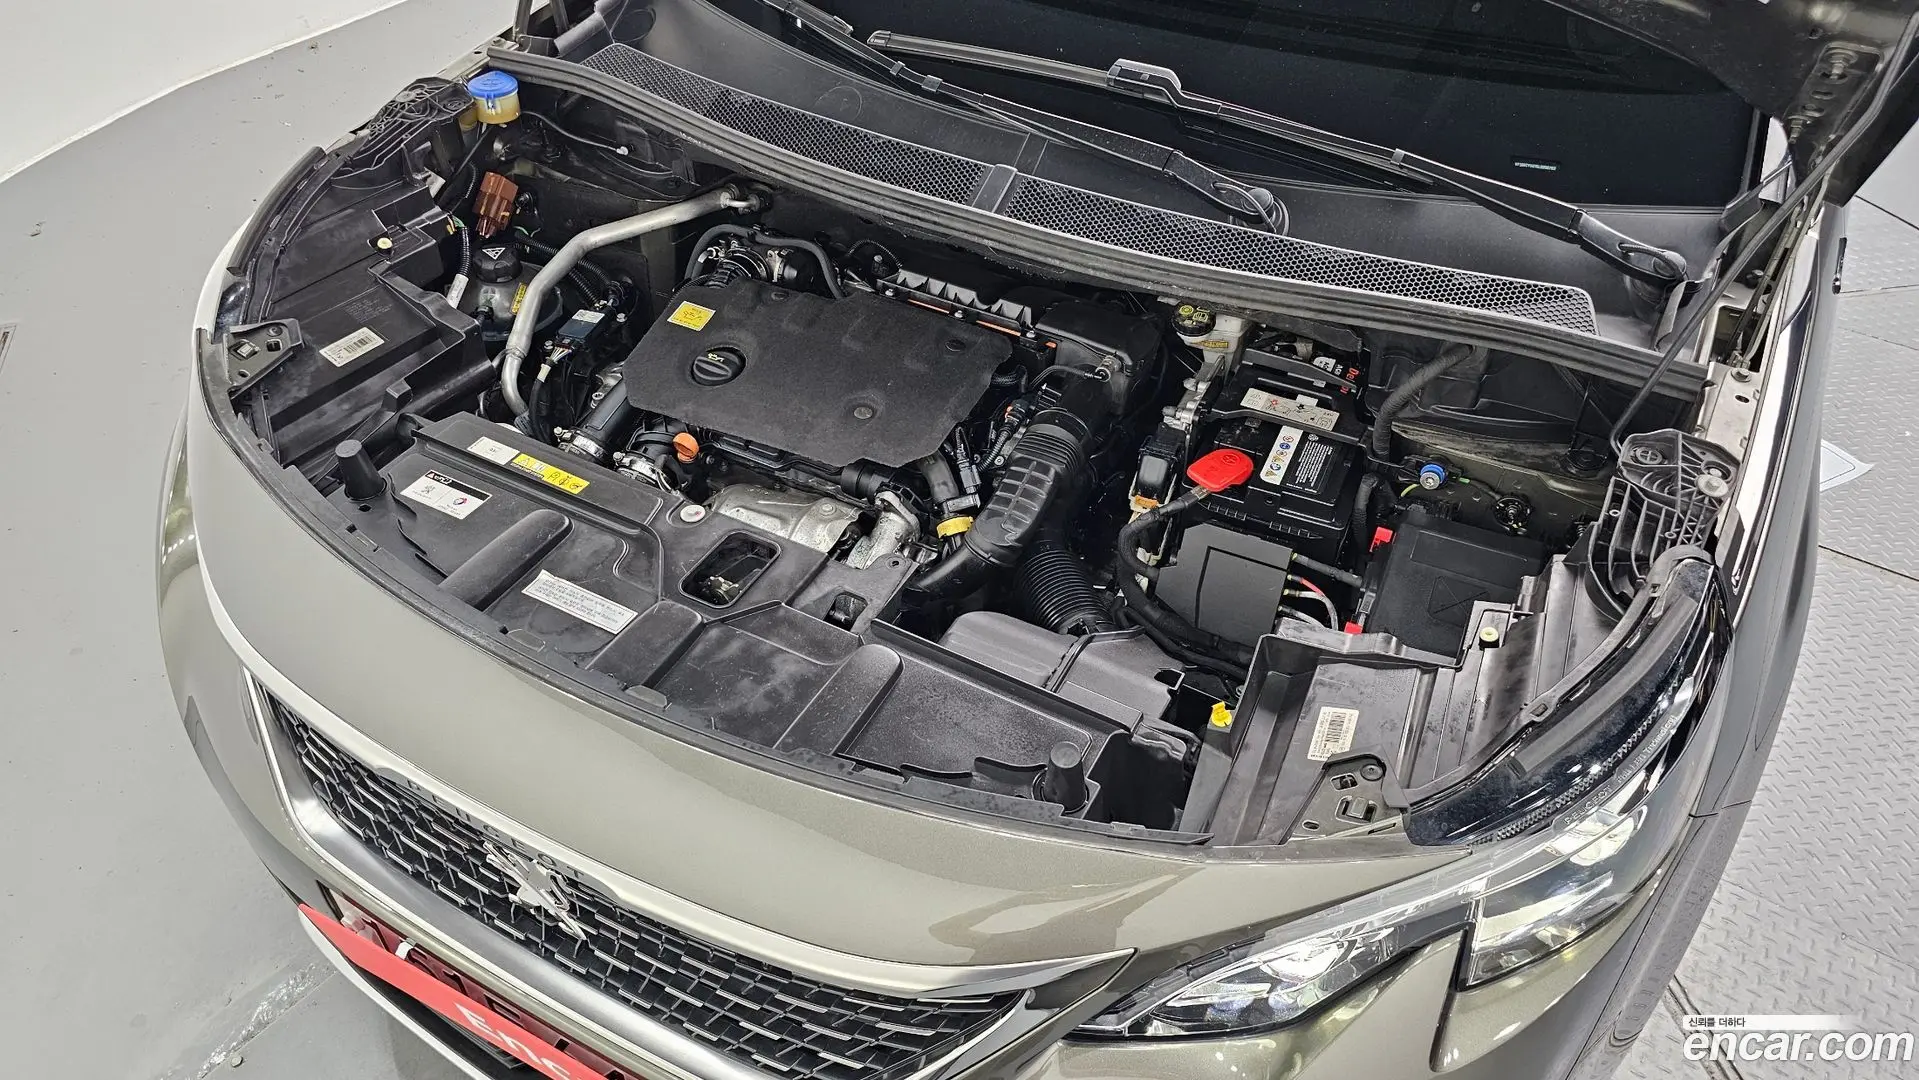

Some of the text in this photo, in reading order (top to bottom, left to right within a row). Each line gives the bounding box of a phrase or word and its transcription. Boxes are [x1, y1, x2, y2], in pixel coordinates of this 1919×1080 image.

[407, 779, 585, 879] PEUGEOT
[1564, 785, 1611, 824] PEUGEOT
[454, 1002, 582, 1080] Enc
